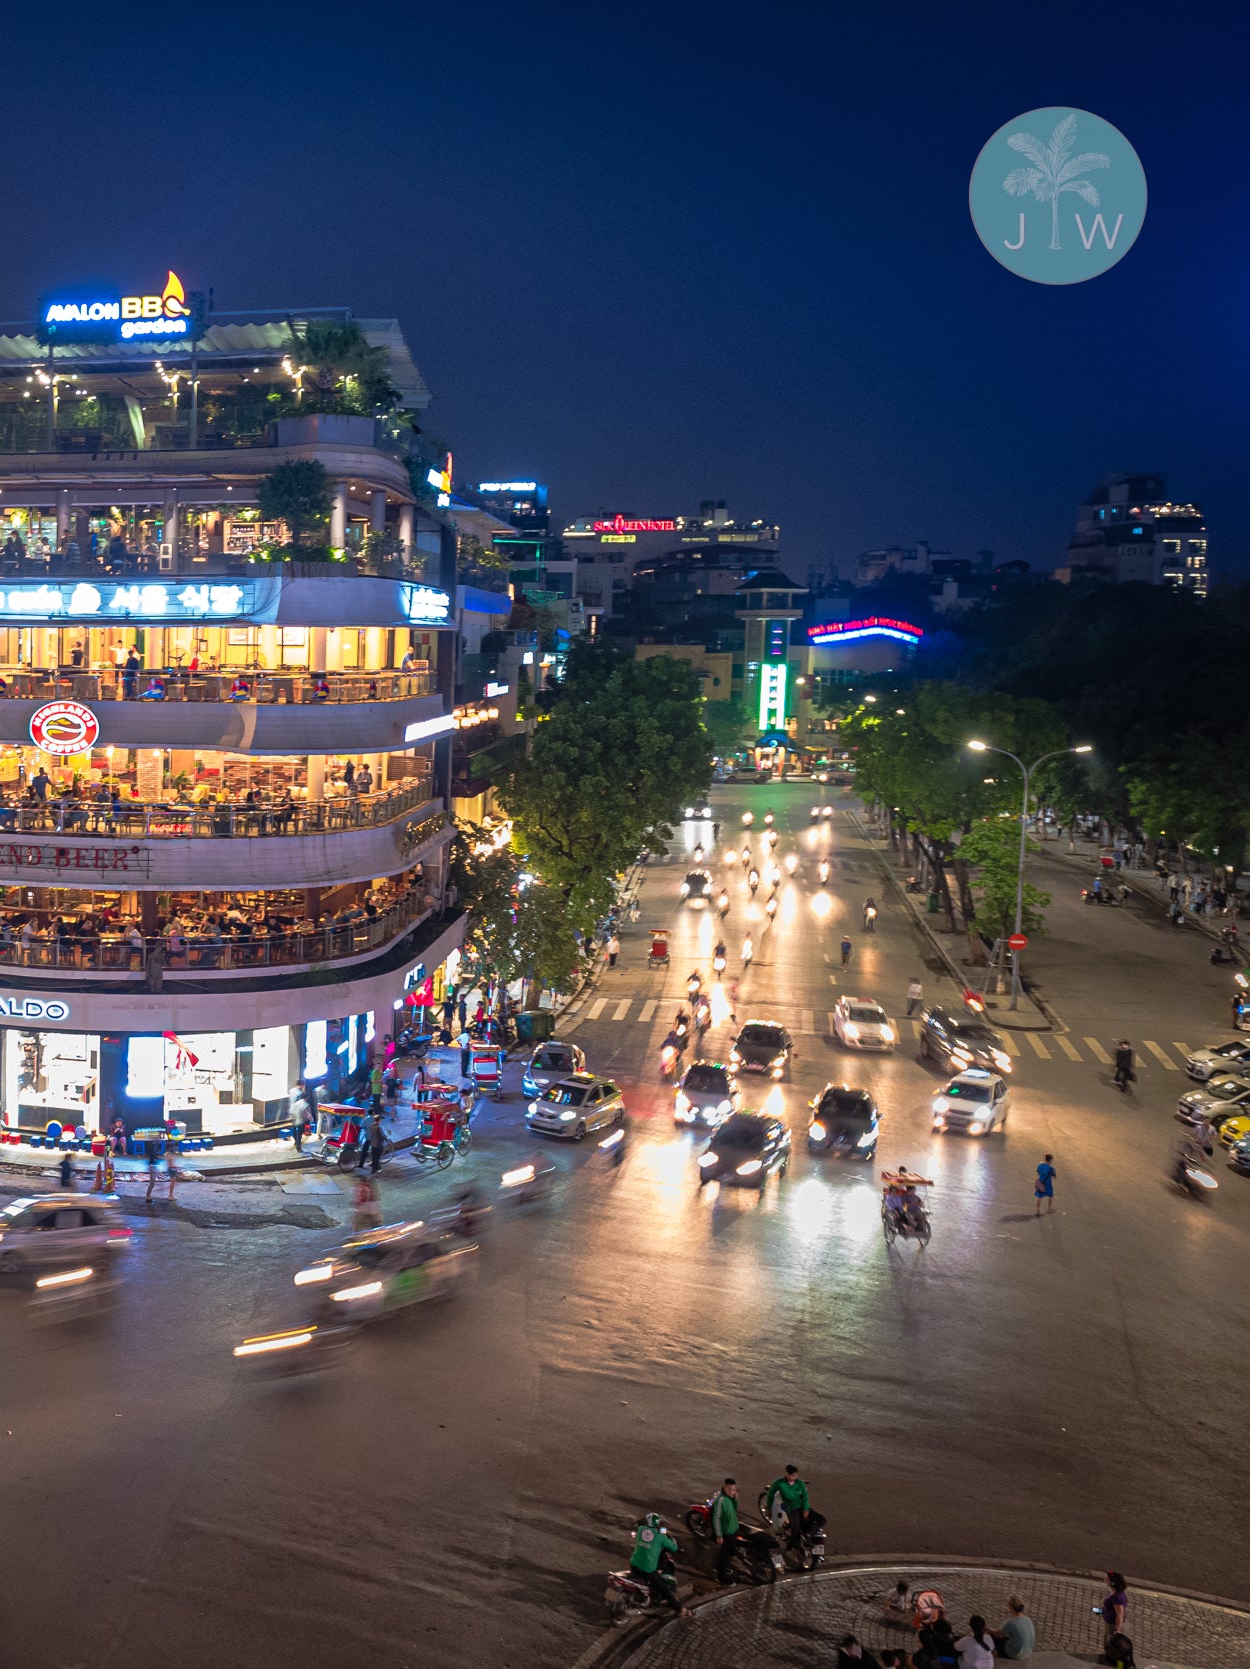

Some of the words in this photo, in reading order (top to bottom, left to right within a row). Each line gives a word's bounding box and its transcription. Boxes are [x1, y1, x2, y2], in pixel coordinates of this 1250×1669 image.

[46, 302, 120, 322] AVALON
[121, 318, 186, 338] garden
[33, 704, 96, 727] HIGHLANDS
[40, 739, 89, 753] COFFEE
[54, 846, 129, 870] BEER
